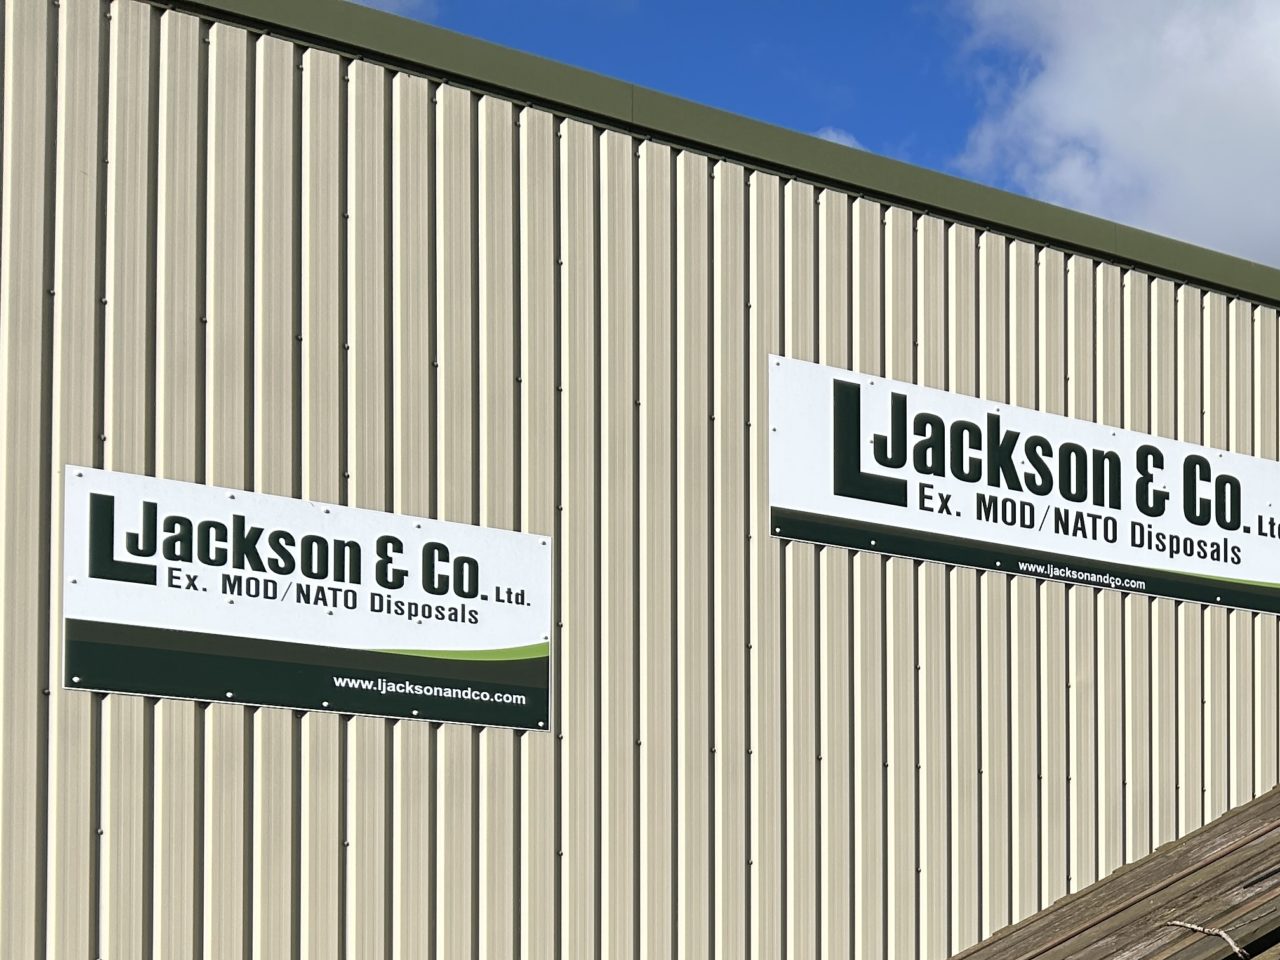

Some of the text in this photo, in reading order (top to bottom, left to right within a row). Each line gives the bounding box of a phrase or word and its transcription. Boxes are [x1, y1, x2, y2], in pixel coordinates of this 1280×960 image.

[1135, 445, 1170, 518] &
[1183, 455, 1251, 534] Co.
[919, 483, 1242, 566] Ex. MOD/NATO Disposals
[167, 568, 479, 625] Ex. MOD/NATO Disposals
[376, 535, 409, 590] &
[422, 541, 489, 601] Co.
[495, 587, 532, 607] Ltd.
[1018, 560, 1146, 590] www.ljacksonandco.com
[332, 676, 526, 705] www.ljacksonandco.com
